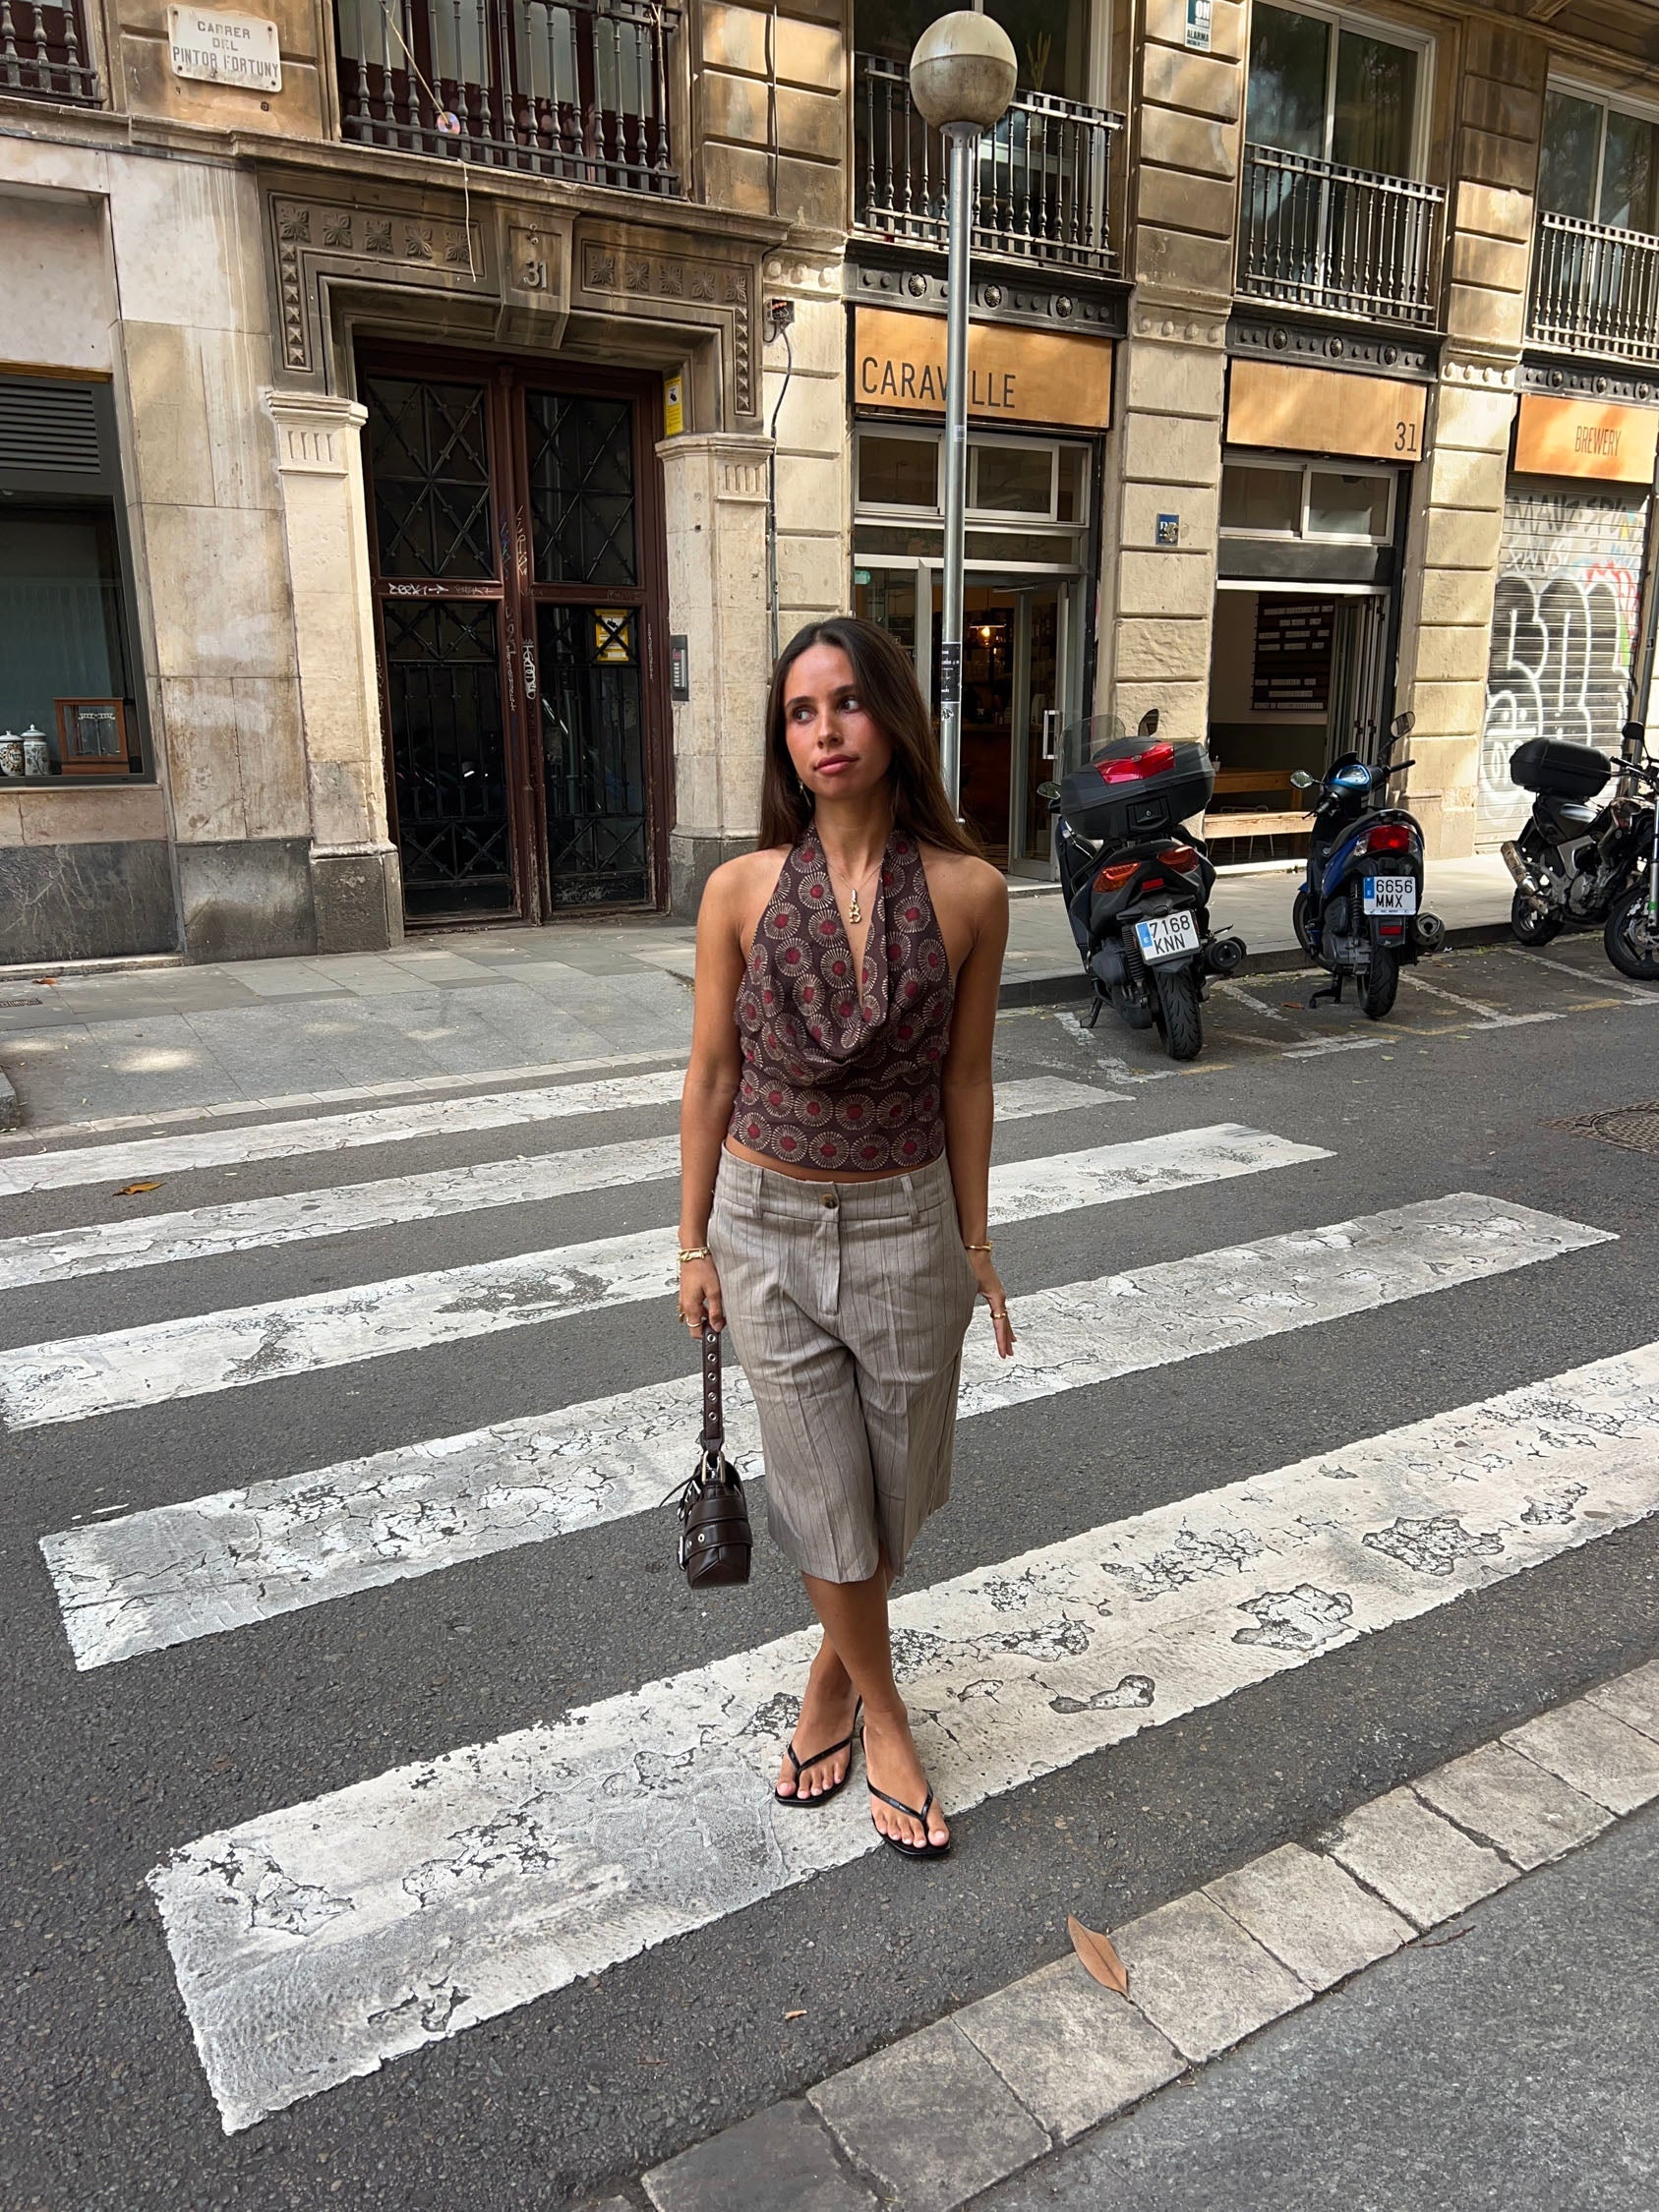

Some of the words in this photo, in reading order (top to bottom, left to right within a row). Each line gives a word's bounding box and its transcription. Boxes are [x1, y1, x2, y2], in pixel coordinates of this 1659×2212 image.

[197, 21, 251, 39] CARRER
[211, 37, 239, 51] DEL
[172, 46, 218, 70] PINTOR
[223, 54, 278, 78] FORTUNY
[523, 258, 547, 288] 31
[861, 356, 1017, 409] CARAVLLE
[1393, 421, 1417, 452] 31
[1574, 425, 1622, 456] BREWERY
[1377, 879, 1413, 894] 6656
[1376, 895, 1402, 907] MMX
[1149, 914, 1191, 939] 7168
[1154, 933, 1186, 955] KNN
